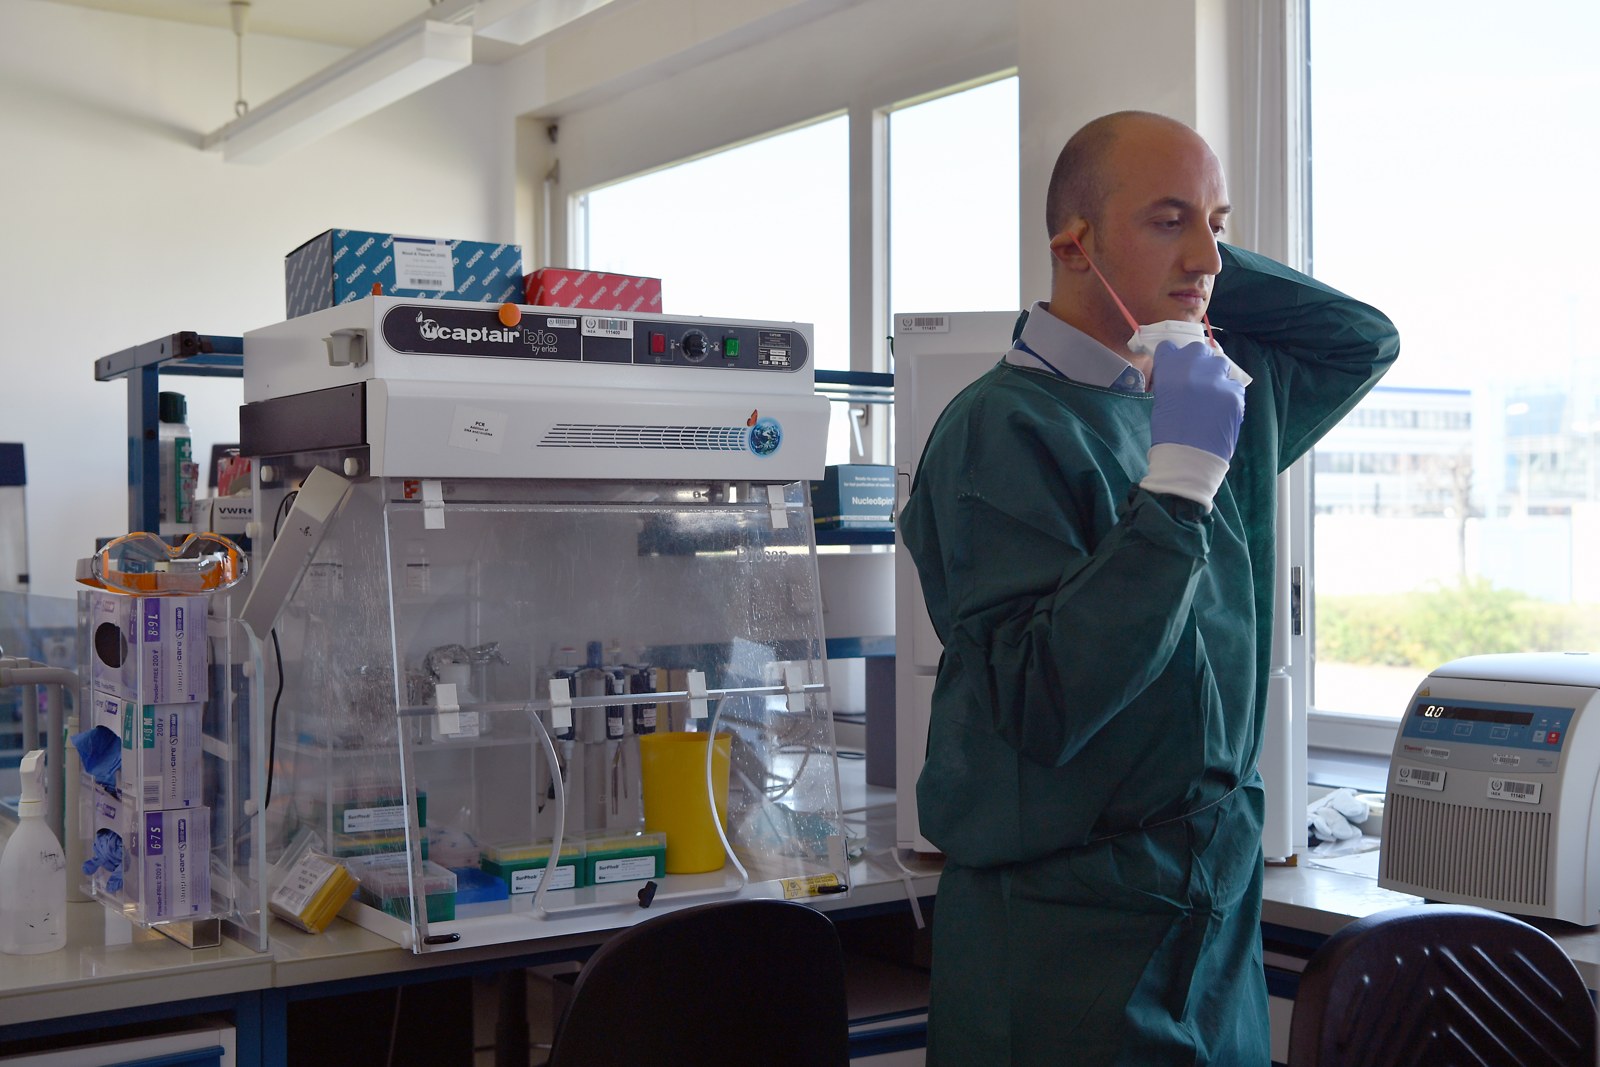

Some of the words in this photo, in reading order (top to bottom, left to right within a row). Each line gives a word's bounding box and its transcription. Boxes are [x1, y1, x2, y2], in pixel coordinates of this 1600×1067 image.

[466, 248, 484, 268] QIAGEN
[346, 263, 366, 284] QIAGEN
[482, 267, 500, 286] QIAGEN
[550, 276, 568, 296] QIAGEN
[612, 279, 630, 297] QIAGEN
[437, 326, 520, 343] captair
[523, 329, 557, 345] bio
[532, 345, 540, 355] by
[541, 345, 557, 353] erlab
[147, 621, 159, 636] 8-9
[150, 834, 161, 849] 6-7
